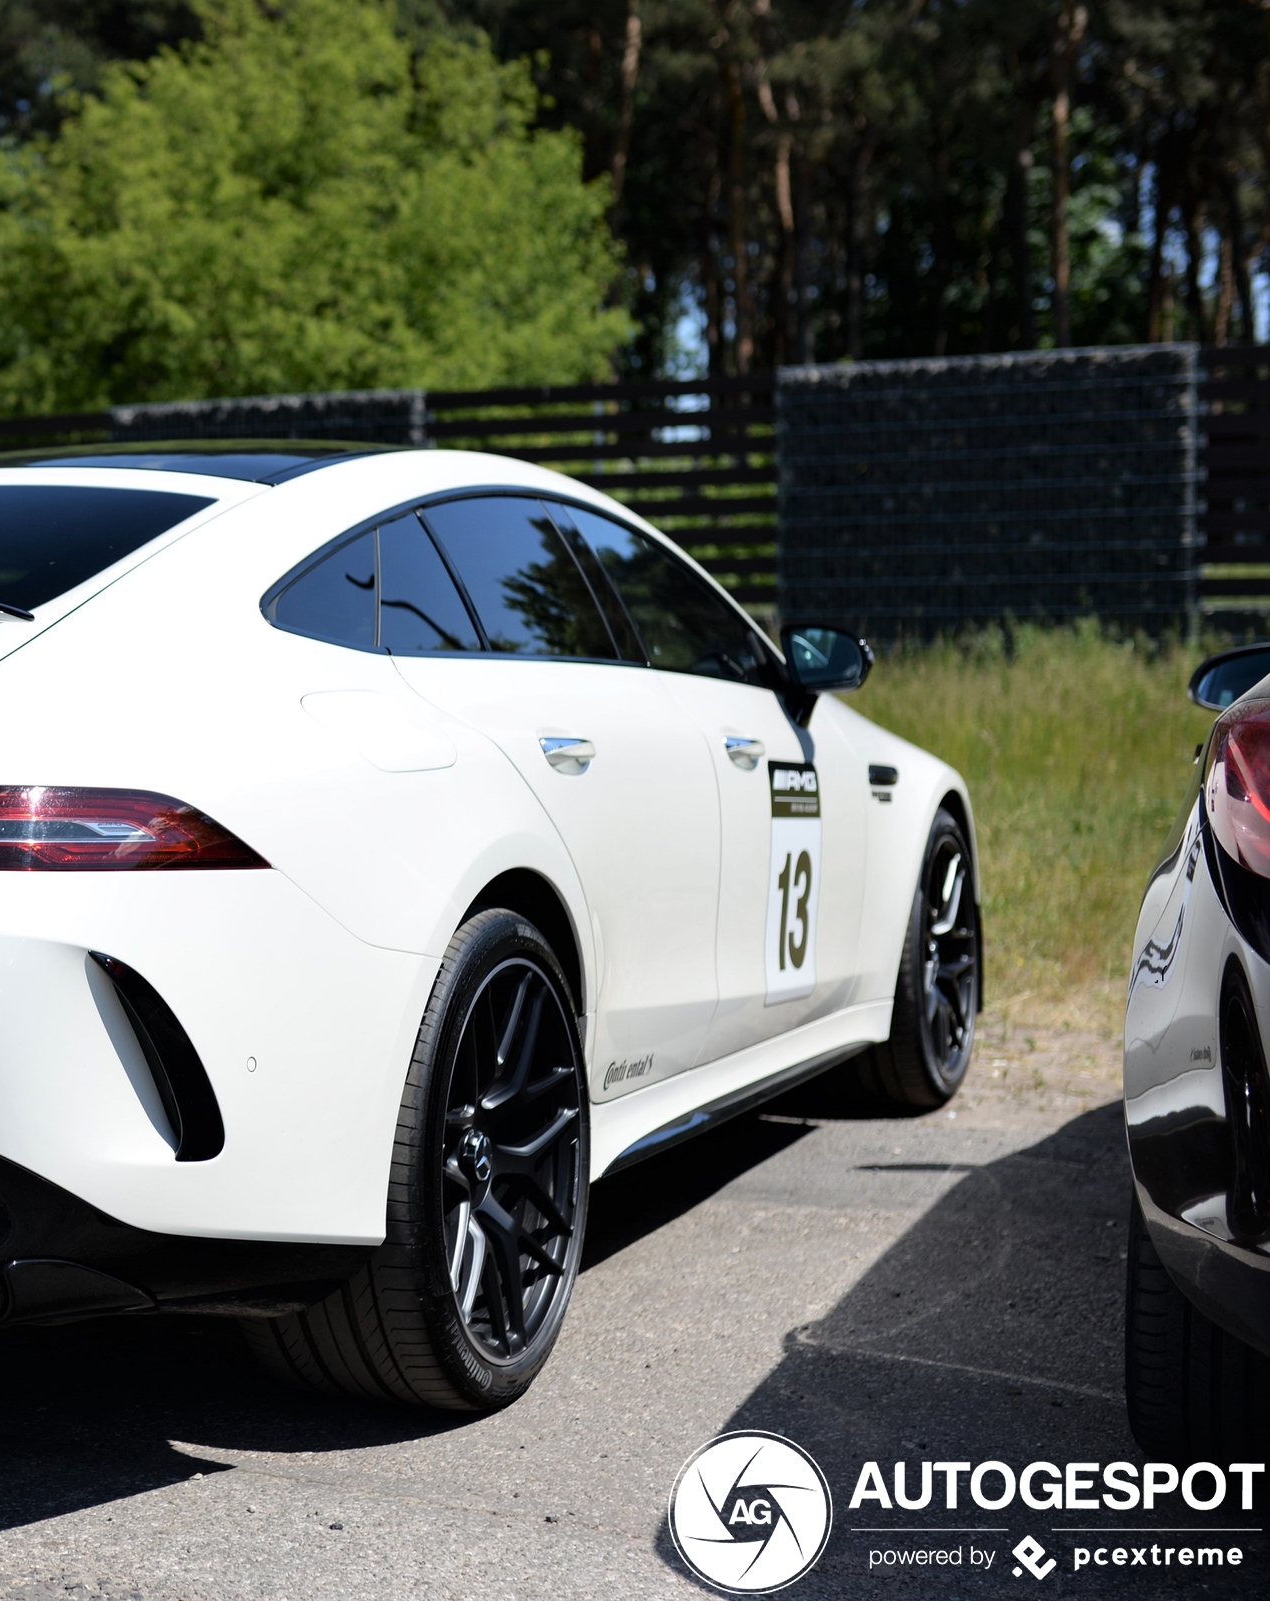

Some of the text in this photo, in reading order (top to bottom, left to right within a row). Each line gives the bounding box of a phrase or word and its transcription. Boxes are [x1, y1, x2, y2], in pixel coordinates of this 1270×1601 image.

[783, 769, 817, 792] AMG
[778, 850, 812, 971] 13
[445, 1319, 493, 1391] Continental
